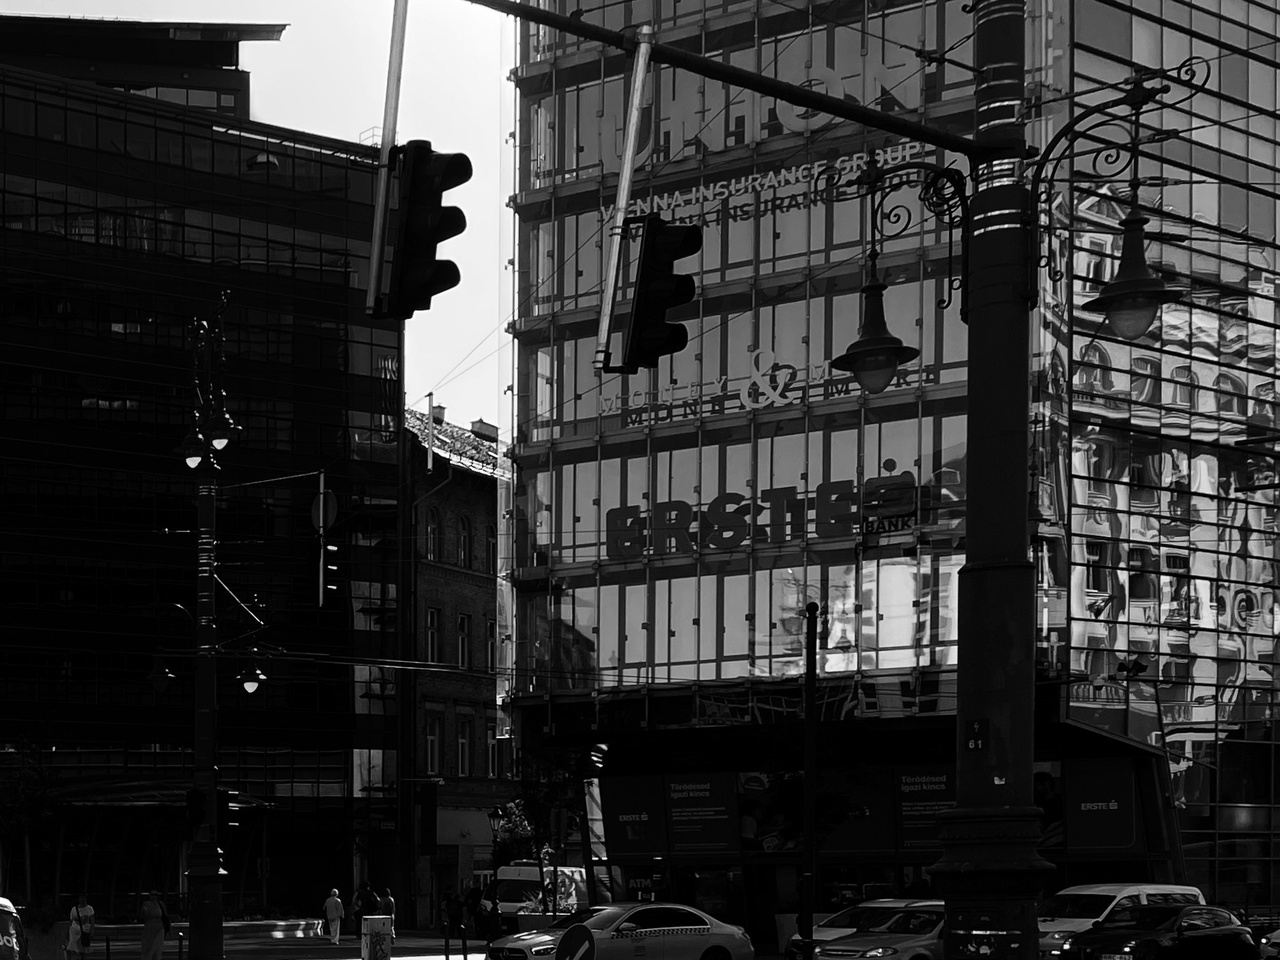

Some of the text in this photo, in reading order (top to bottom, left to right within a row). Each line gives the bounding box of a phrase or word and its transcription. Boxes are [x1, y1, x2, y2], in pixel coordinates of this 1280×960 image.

[600, 190, 685, 221] VENNA
[690, 159, 828, 205] INSURANCE
[600, 375, 727, 415] MONEY
[739, 350, 795, 410] &
[606, 479, 854, 561] ERSTE
[865, 517, 912, 535] BANK
[968, 739, 983, 749] 61
[923, 782, 946, 791] kincs
[1080, 802, 1108, 811] ERSTE
[619, 814, 641, 822] ERSTE
[628, 878, 652, 889] ATM
